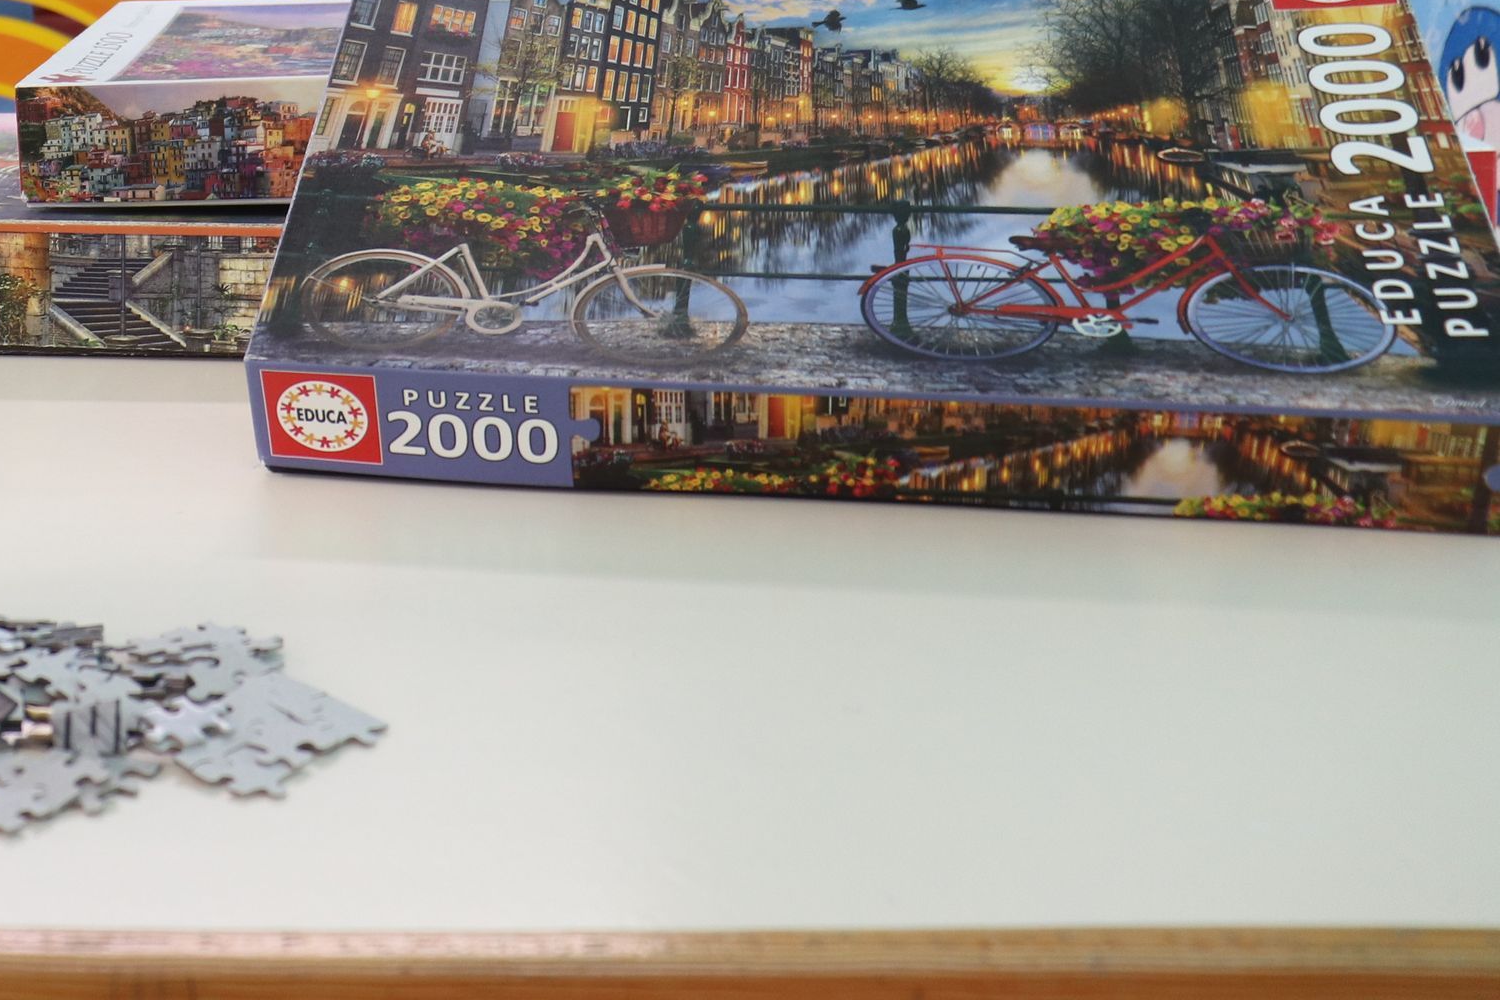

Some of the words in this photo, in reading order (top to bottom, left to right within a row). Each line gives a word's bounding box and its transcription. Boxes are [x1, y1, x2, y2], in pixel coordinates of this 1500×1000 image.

[64, 48, 113, 75] PUZZLE
[1297, 22, 1435, 176] 2000
[1349, 196, 1424, 327] EDUCA
[1404, 193, 1489, 338] PUZZLE
[296, 407, 348, 426] EDUCA
[402, 389, 540, 414] PUZZLE
[386, 411, 560, 464] 2000
